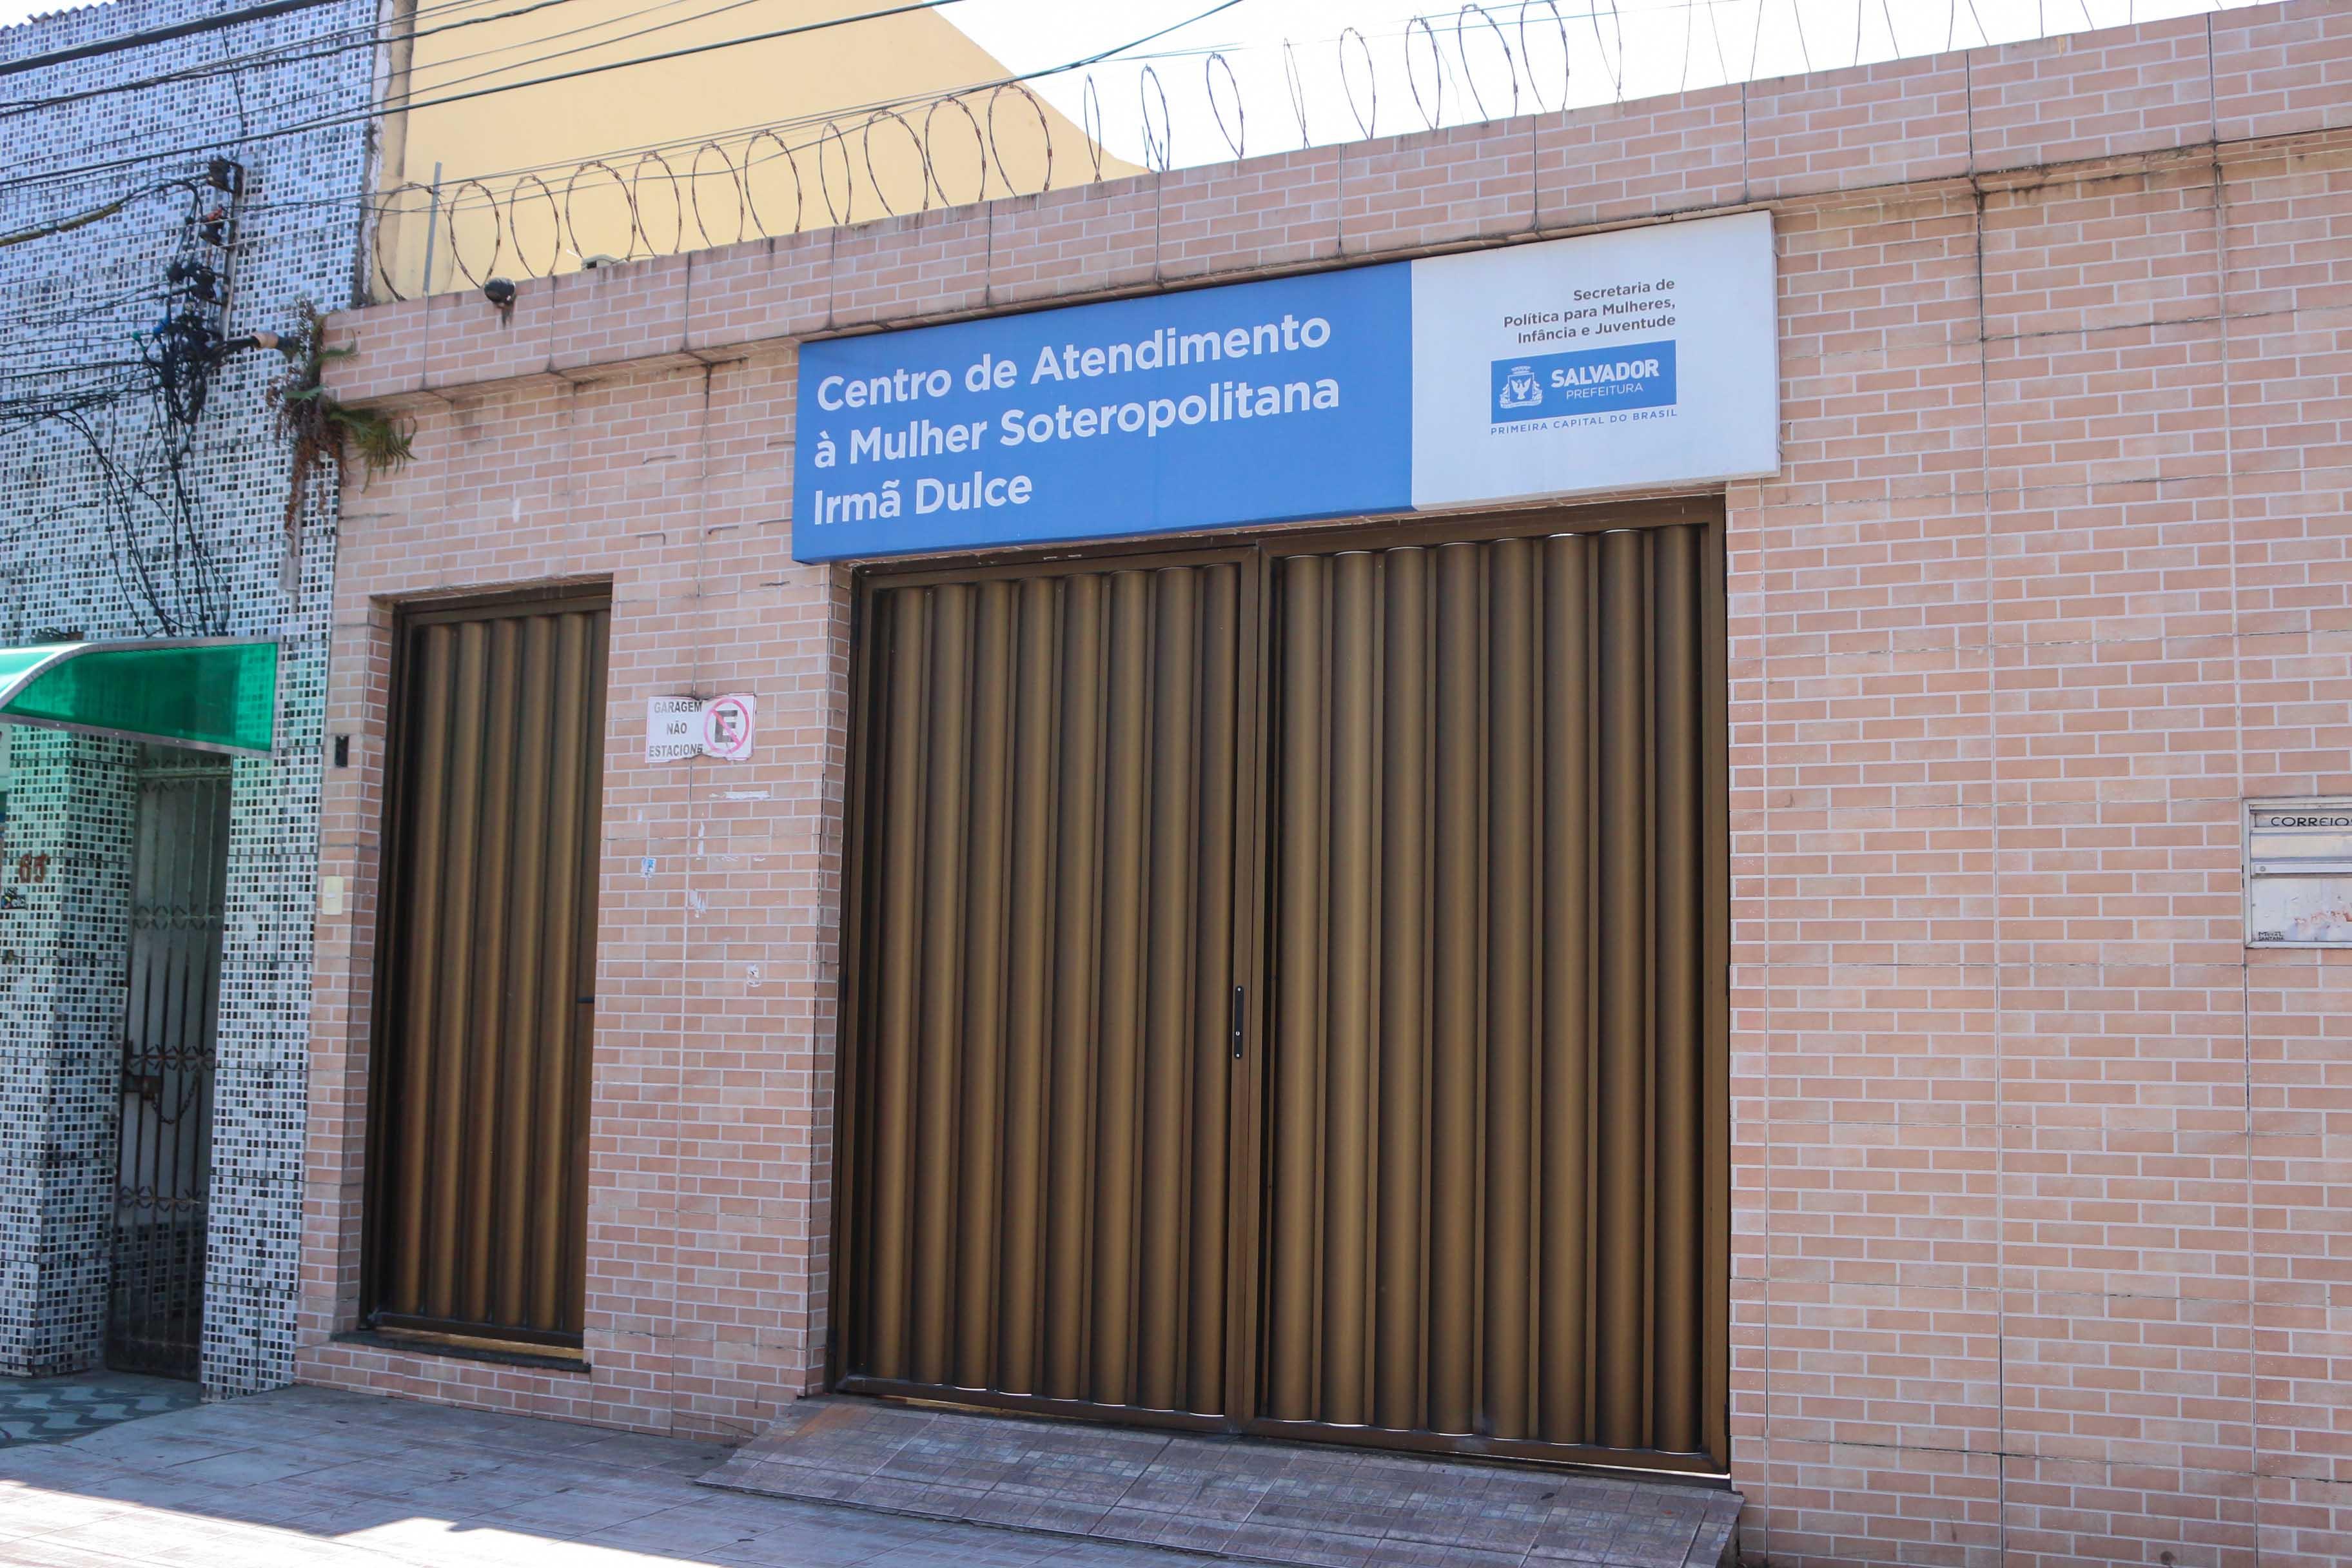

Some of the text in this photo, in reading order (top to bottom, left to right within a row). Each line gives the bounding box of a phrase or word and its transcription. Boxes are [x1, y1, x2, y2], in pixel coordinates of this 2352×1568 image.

[1573, 279, 1675, 301] Secretaria de
[1504, 299, 1676, 328] Política para Mulheres,
[1518, 315, 1676, 344] Infância e Juventude
[818, 314, 1331, 411] Centro de Atendimento
[1551, 358, 1660, 388] SALVADOR
[1566, 382, 1643, 400] PREFEITURA
[814, 378, 1339, 468] à Mulher Soteropolitana
[1491, 409, 1677, 435] PRIMEIRA CAPITAL DO BRASIL
[814, 471, 1032, 525] Irmã Dulce
[654, 701, 702, 714] GARAGEM
[666, 720, 687, 736] NÃO
[2271, 816, 2352, 827] CORREIO
